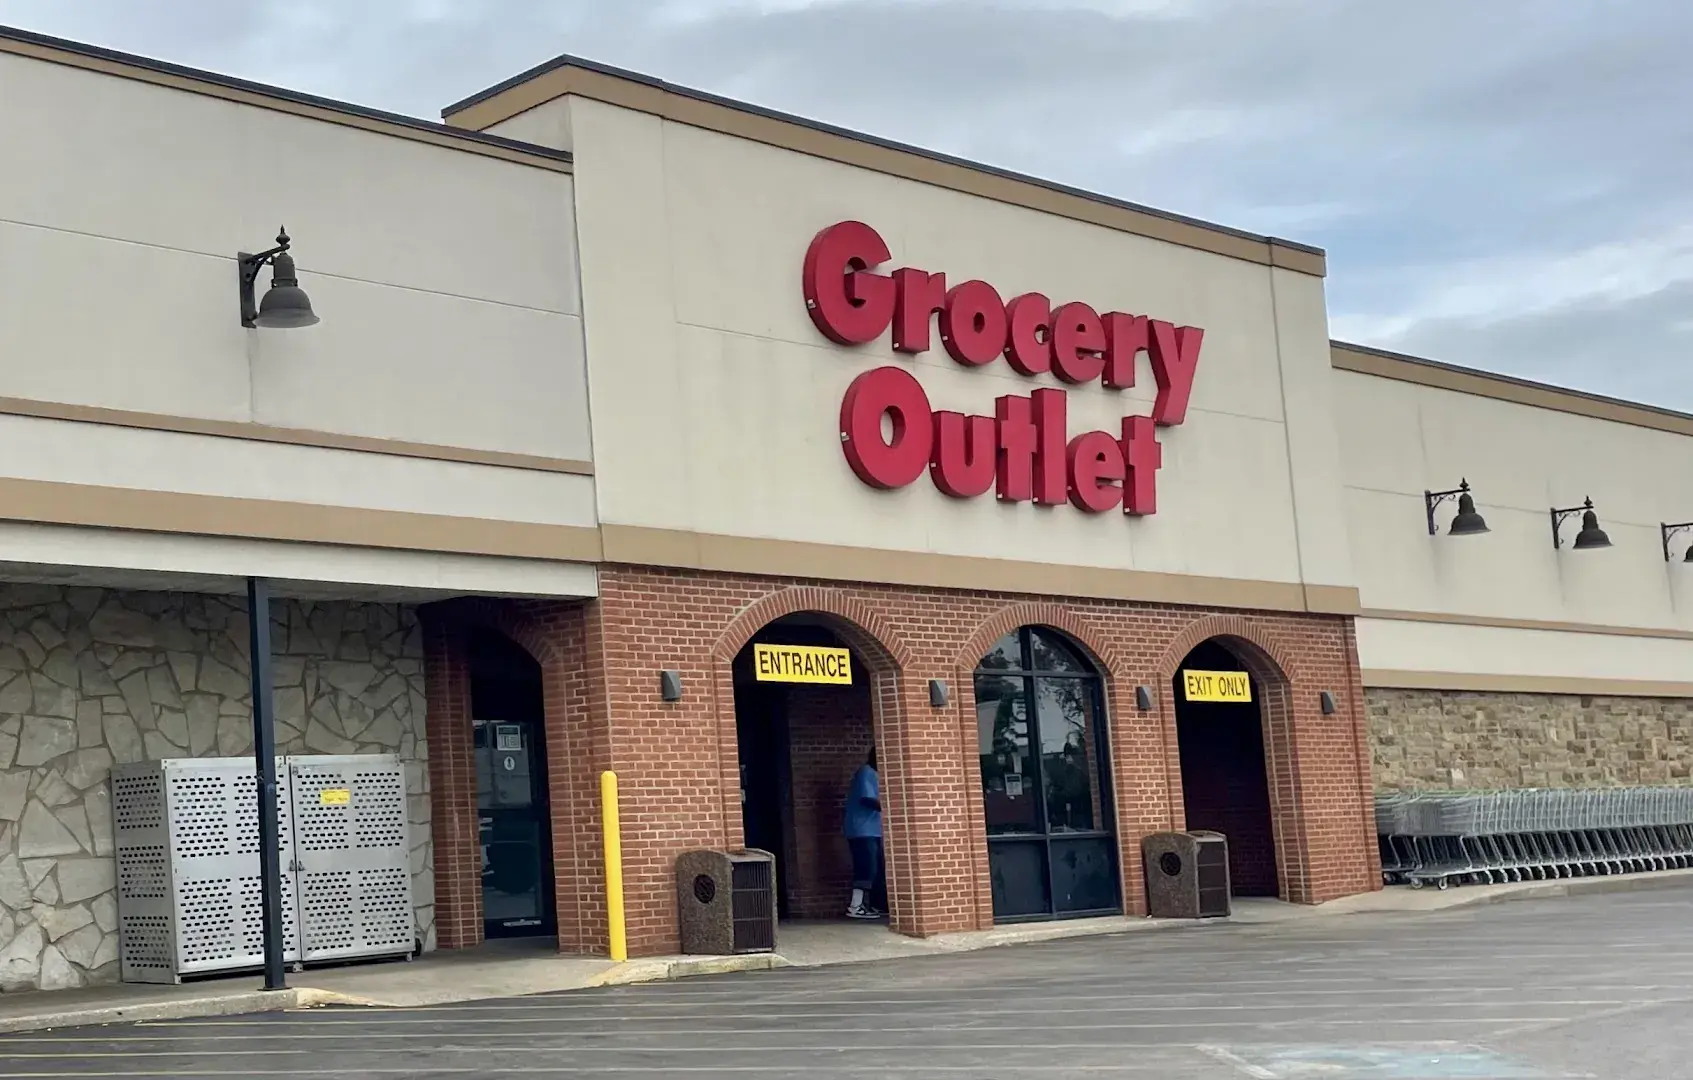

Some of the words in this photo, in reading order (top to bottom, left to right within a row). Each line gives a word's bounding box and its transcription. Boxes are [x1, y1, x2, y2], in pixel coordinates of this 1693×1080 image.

[803, 220, 1204, 425] Grocery
[840, 366, 1161, 515] Outlet
[759, 650, 847, 677] ENTRANCE
[1187, 675, 1212, 695] EXIT
[1218, 676, 1245, 696] ONLY
